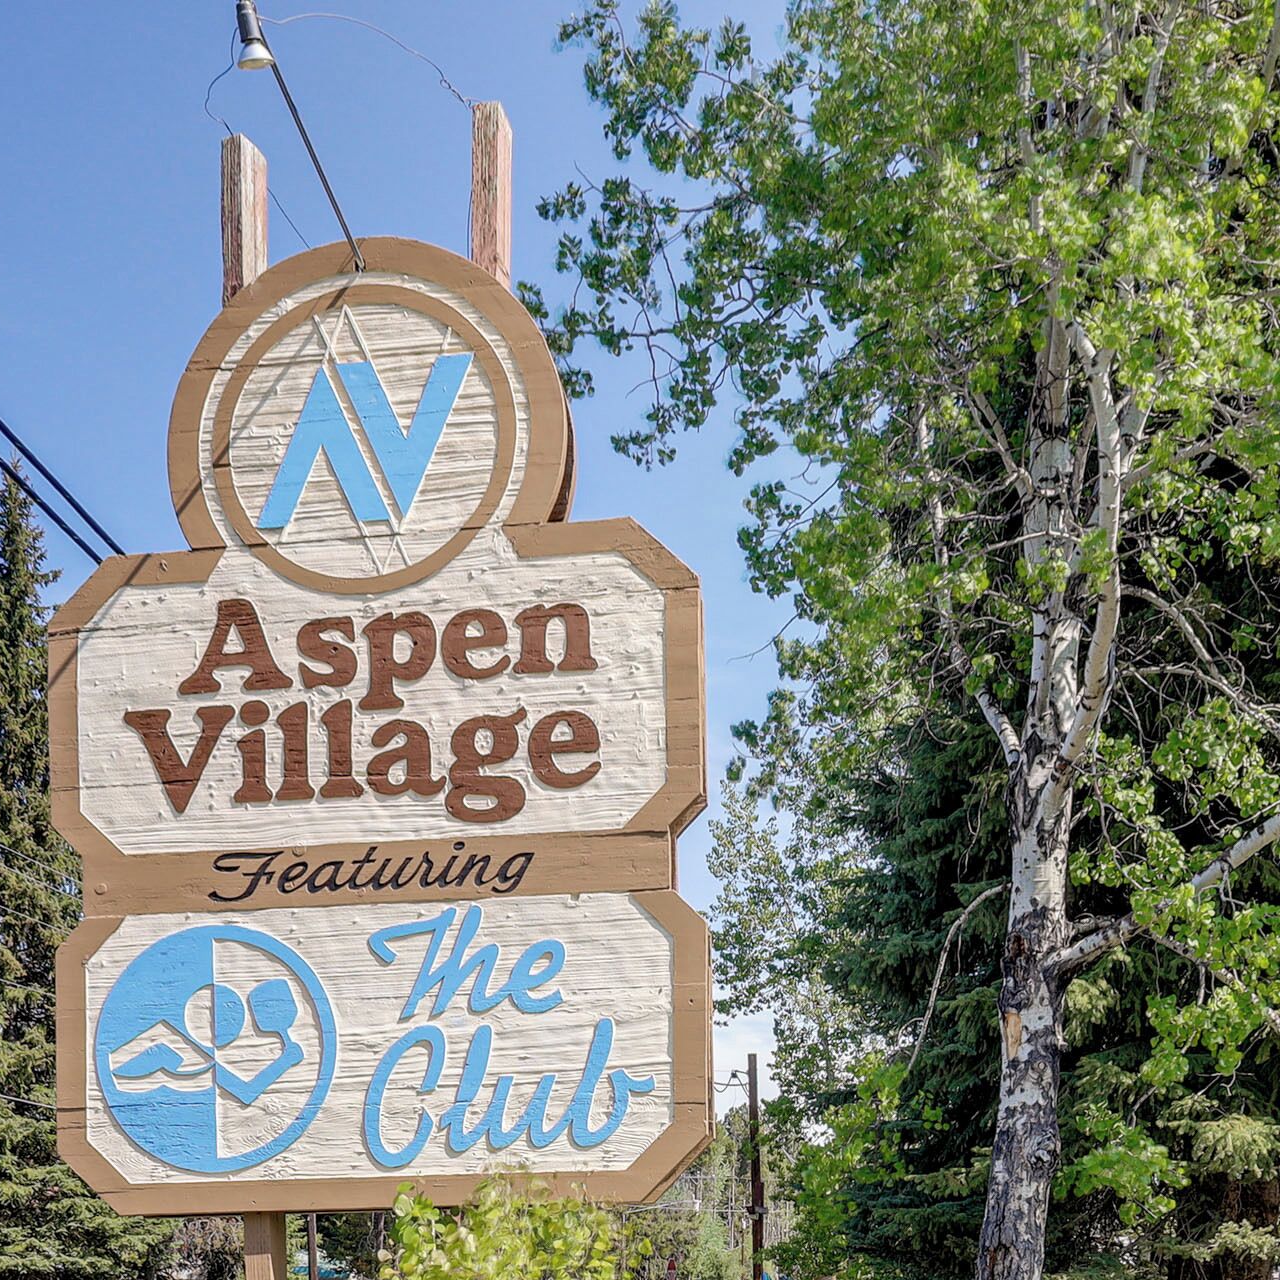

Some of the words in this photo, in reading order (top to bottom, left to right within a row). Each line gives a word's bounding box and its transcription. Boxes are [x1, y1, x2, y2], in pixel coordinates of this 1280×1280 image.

[178, 597, 599, 711] Aspen
[123, 698, 603, 824] Village
[207, 841, 535, 902] Featuring
[367, 904, 567, 1022] The
[364, 1018, 656, 1168] Club
